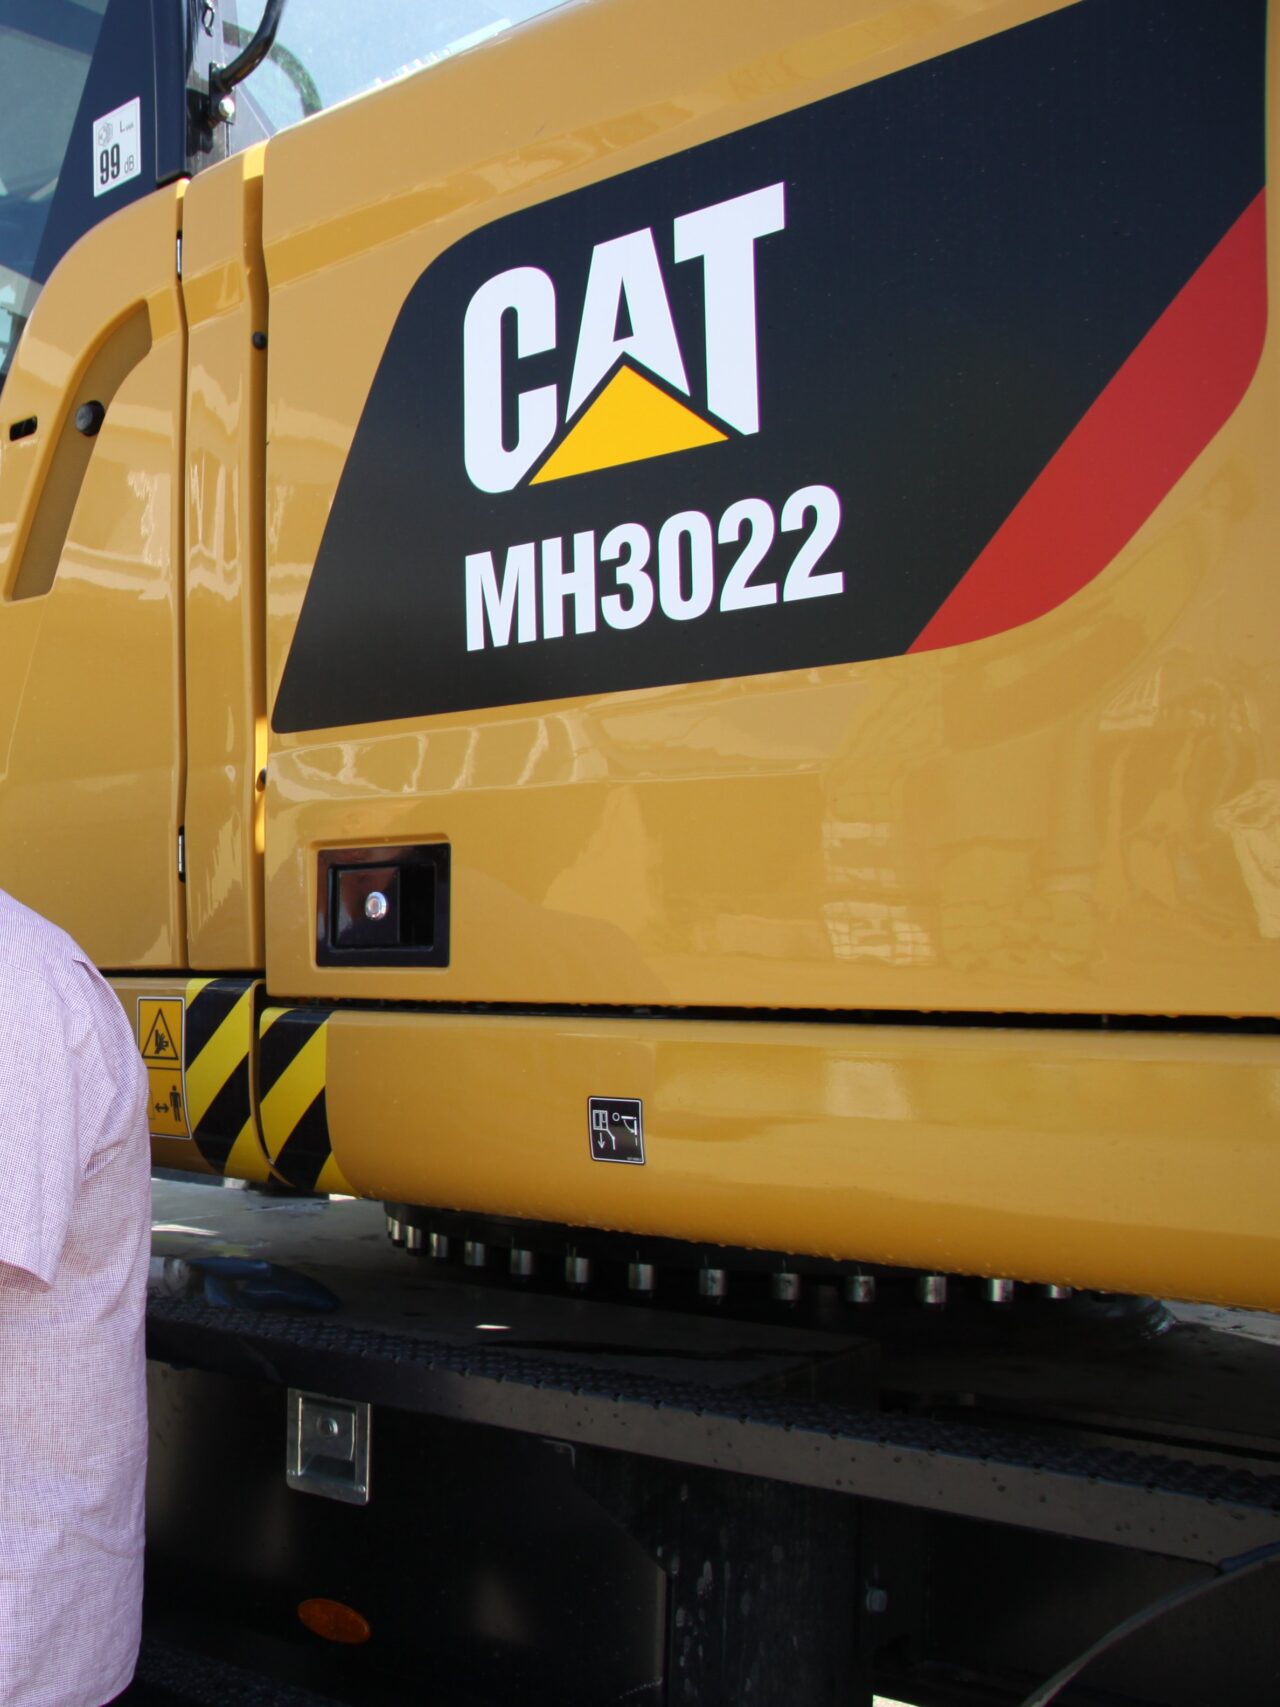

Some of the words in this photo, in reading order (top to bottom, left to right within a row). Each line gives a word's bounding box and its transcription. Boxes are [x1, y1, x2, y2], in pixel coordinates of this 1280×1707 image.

[100, 143, 120, 185] 99
[124, 154, 135, 174] dB
[463, 181, 785, 494] CAT
[465, 485, 844, 652] MH3022
